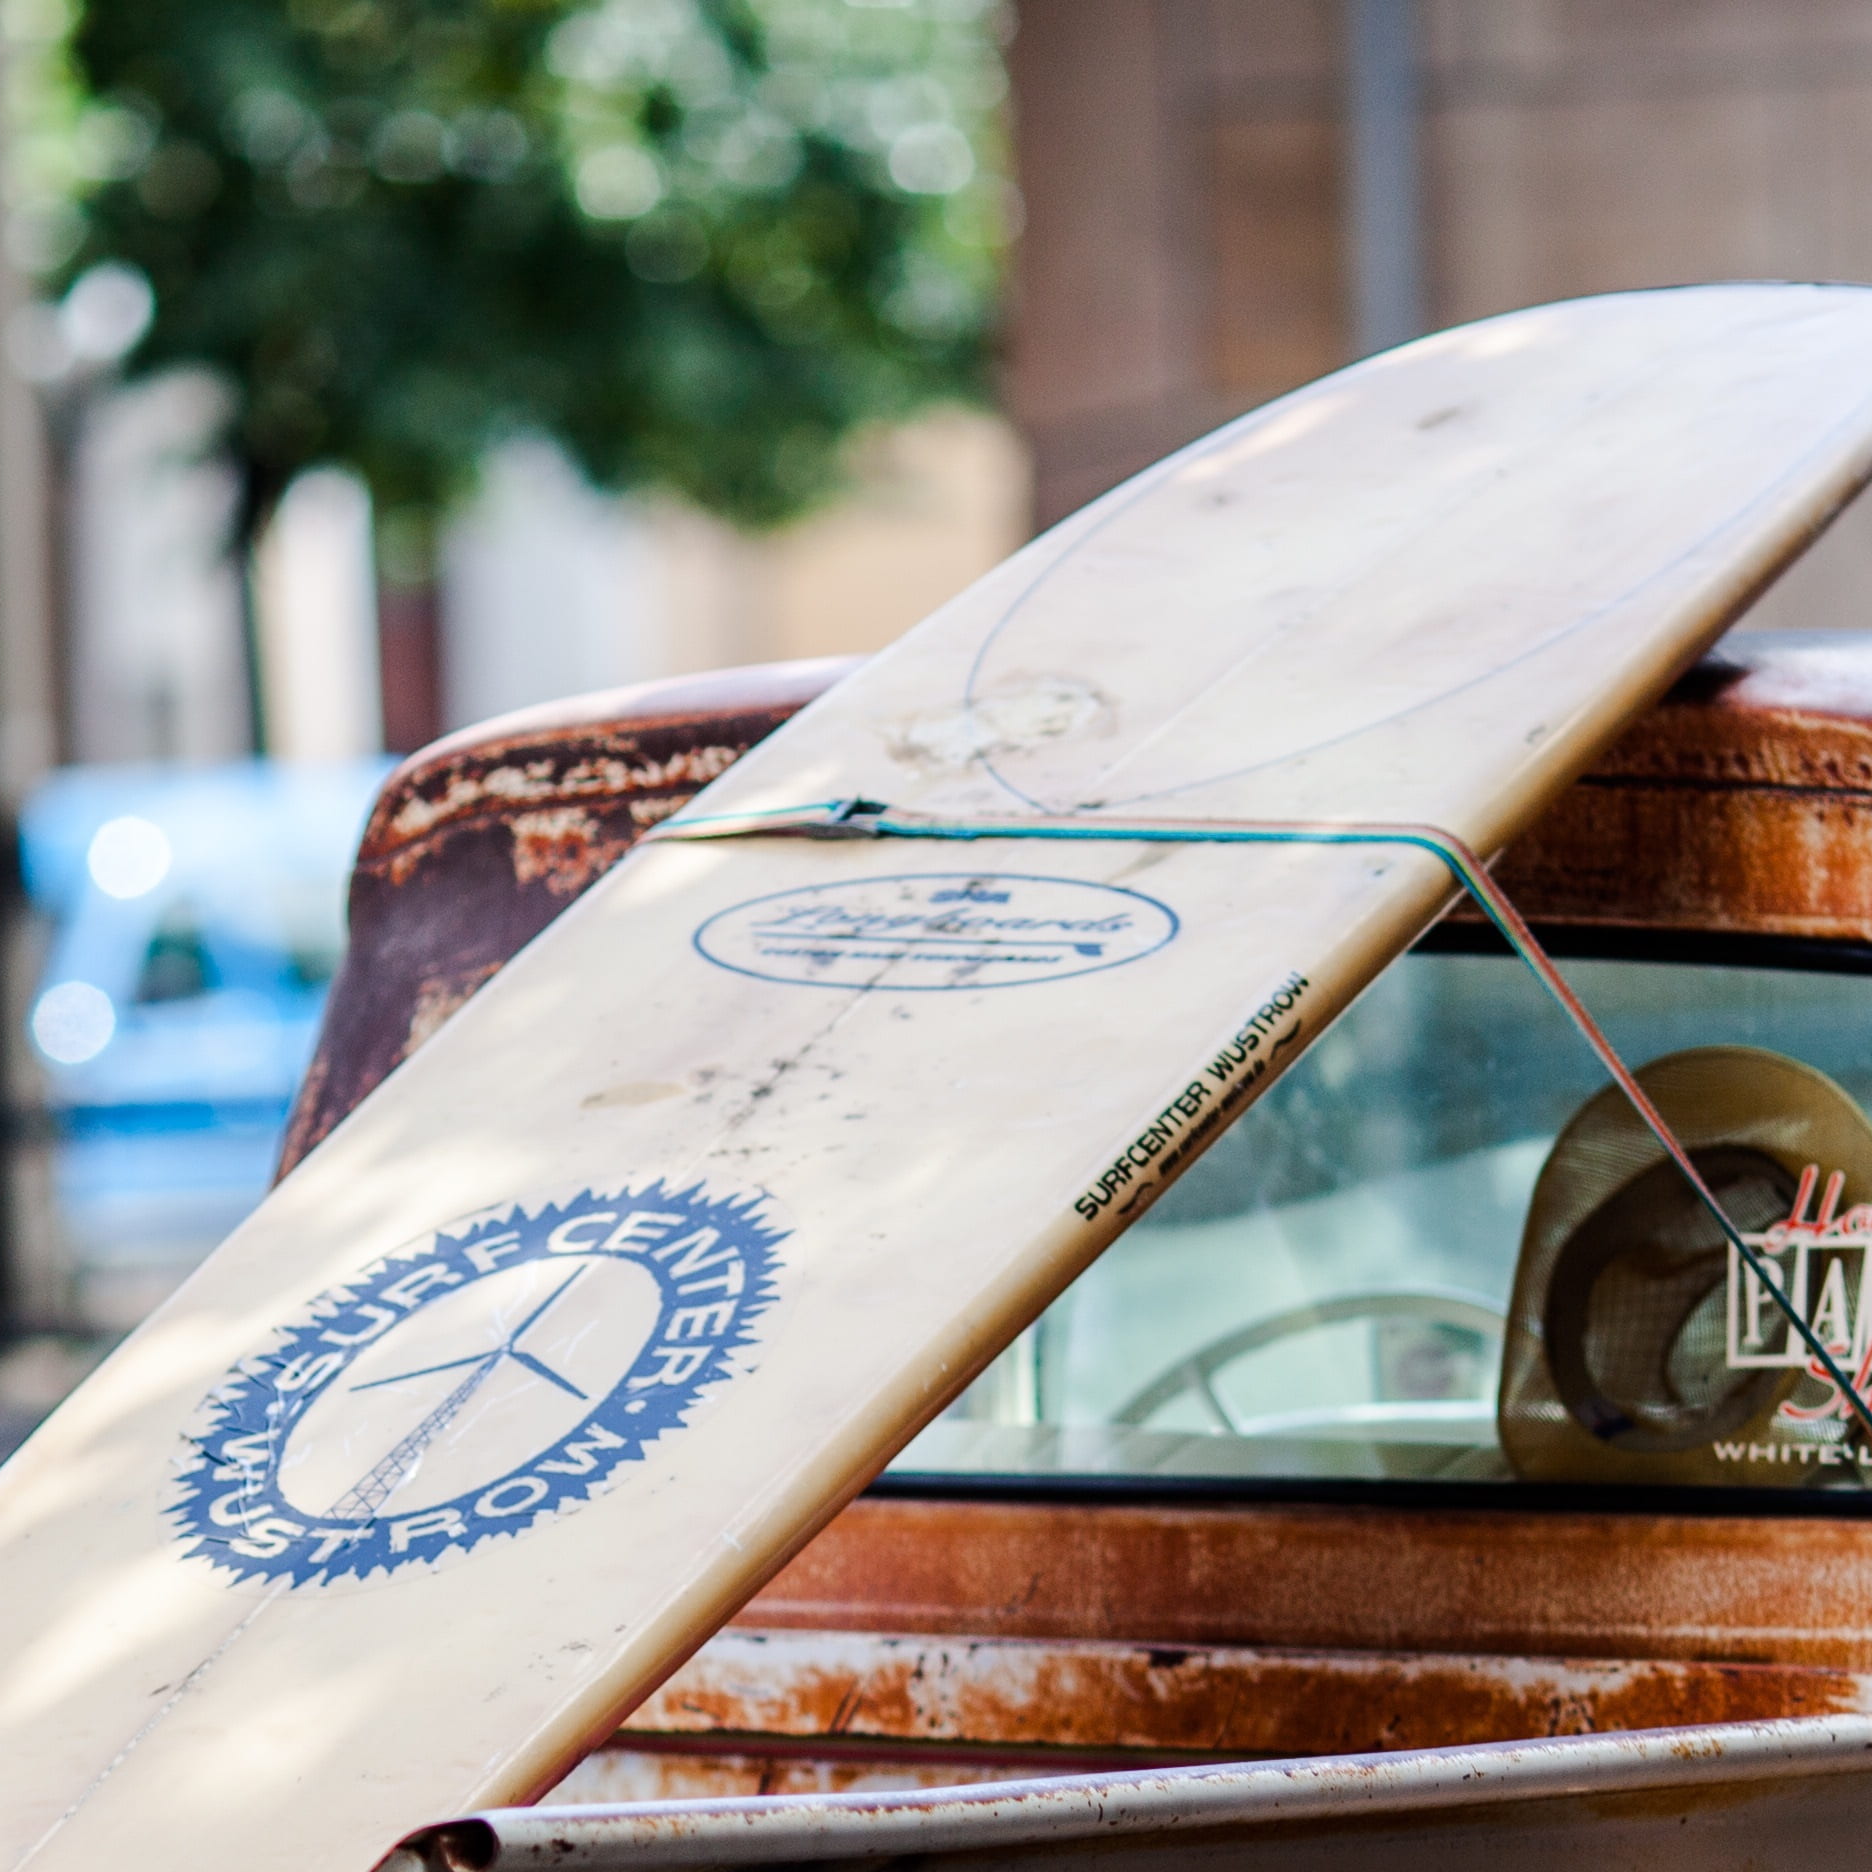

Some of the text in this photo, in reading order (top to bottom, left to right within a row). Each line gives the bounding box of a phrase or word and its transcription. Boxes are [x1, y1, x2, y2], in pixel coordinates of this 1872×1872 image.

[1073, 1080, 1212, 1222] SURFCENTER
[1205, 970, 1310, 1083] WUSTROW
[275, 1211, 746, 1392] SURF CENTER
[208, 1421, 628, 1562] WUSTROW
